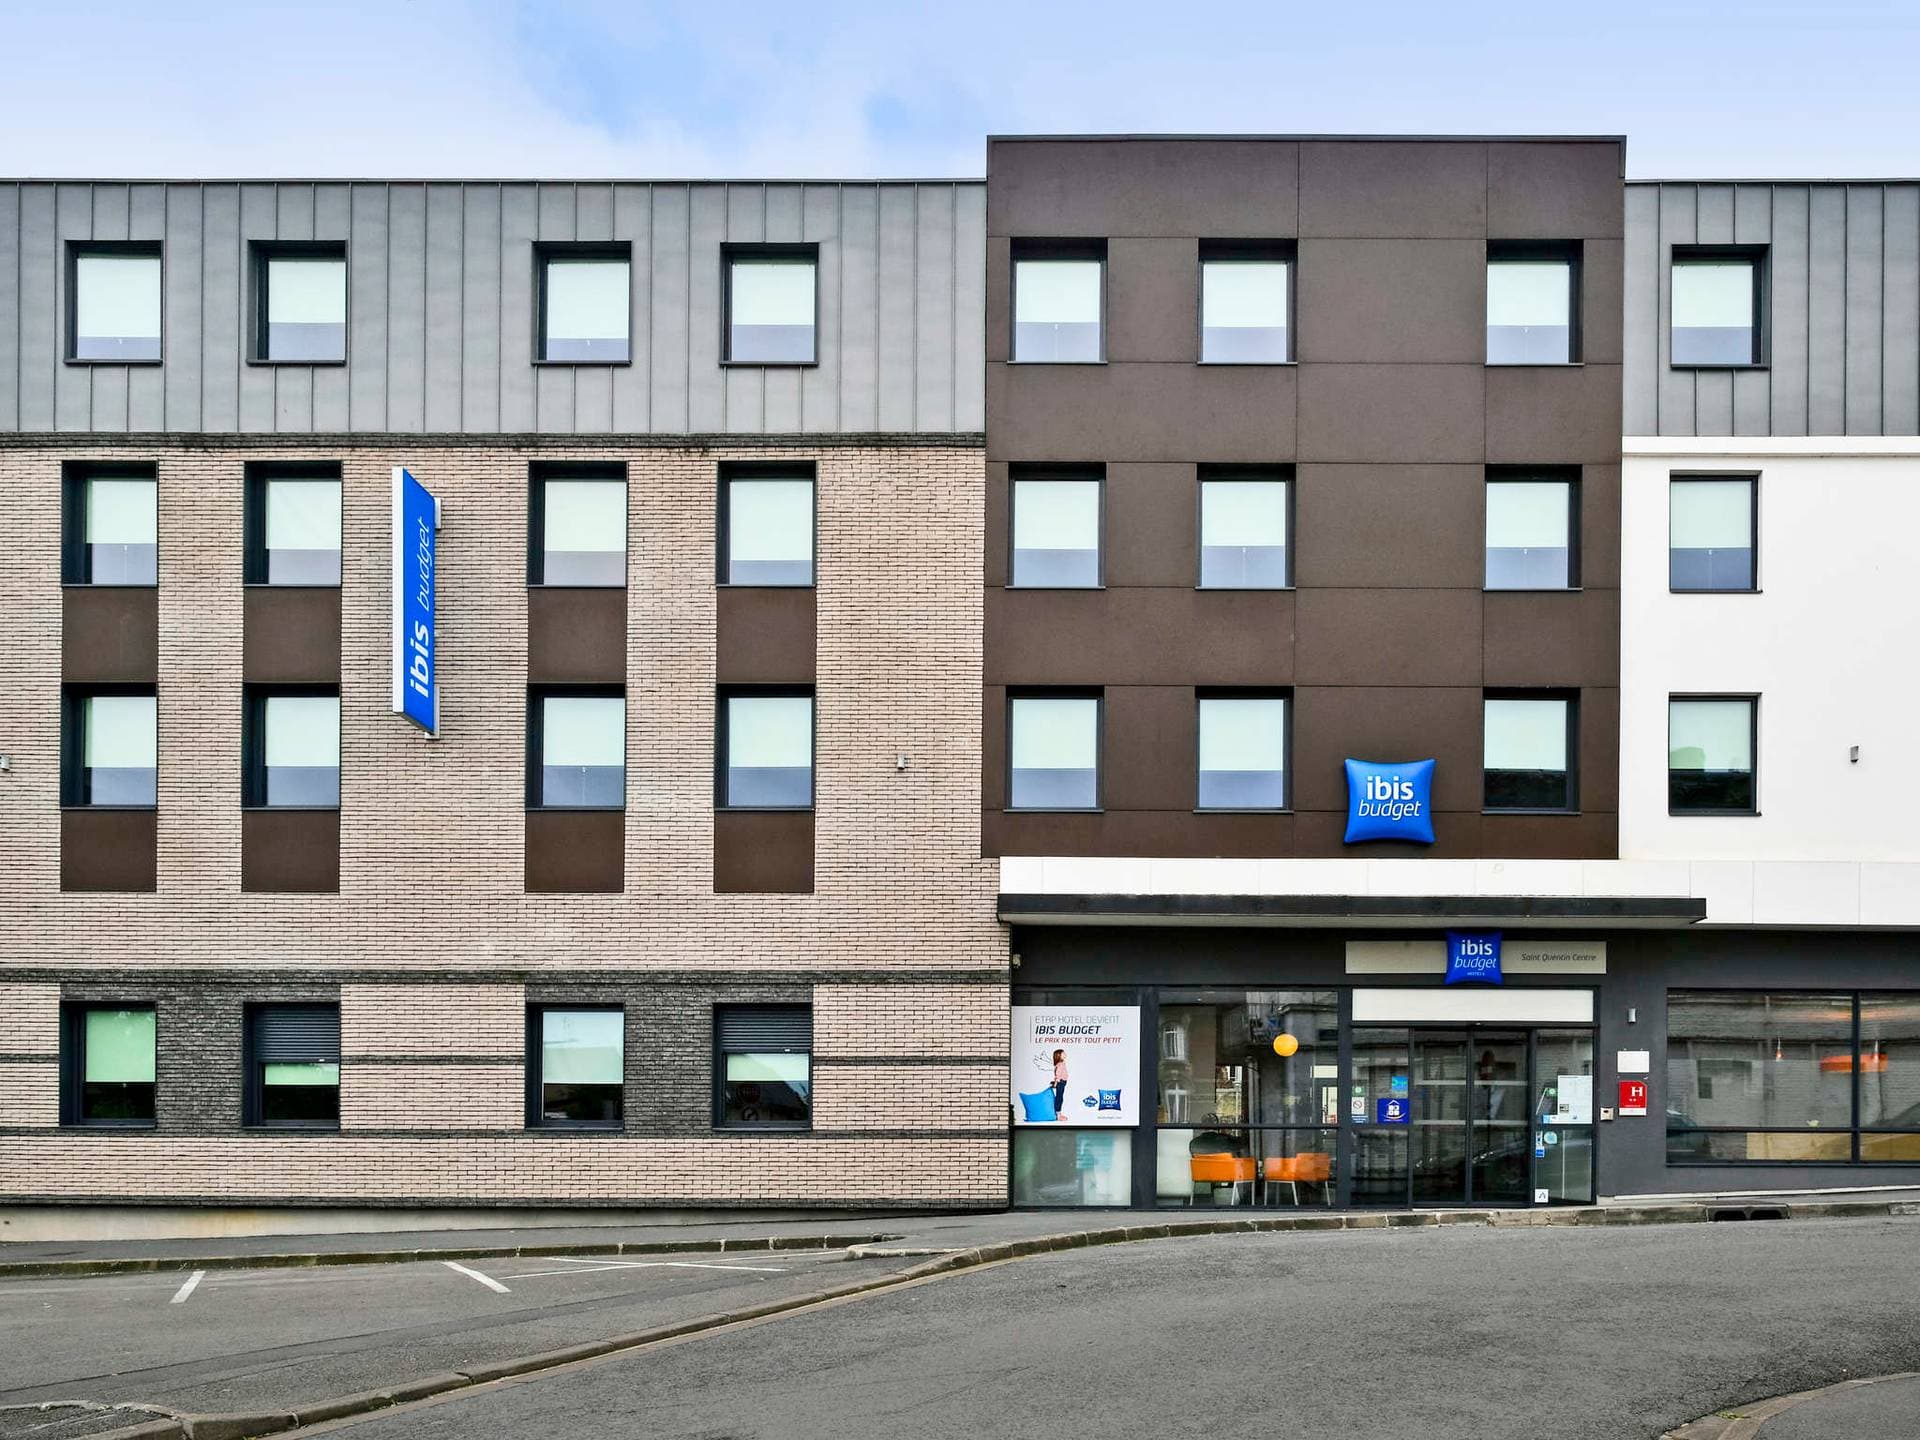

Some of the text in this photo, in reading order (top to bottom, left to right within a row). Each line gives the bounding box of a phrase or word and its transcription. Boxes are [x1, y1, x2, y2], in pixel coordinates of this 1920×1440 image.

[410, 516, 433, 698] ibis budget
[1366, 775, 1414, 801] ibis
[1358, 799, 1422, 821] budget
[1461, 939, 1493, 956] ibis
[1454, 956, 1497, 971] budget
[1521, 953, 1597, 962] Saint Quentin Centre
[1057, 1015, 1083, 1024] HOTEL
[1035, 1025, 1101, 1035] IBIS BUDGET
[1631, 1086, 1643, 1097] H
